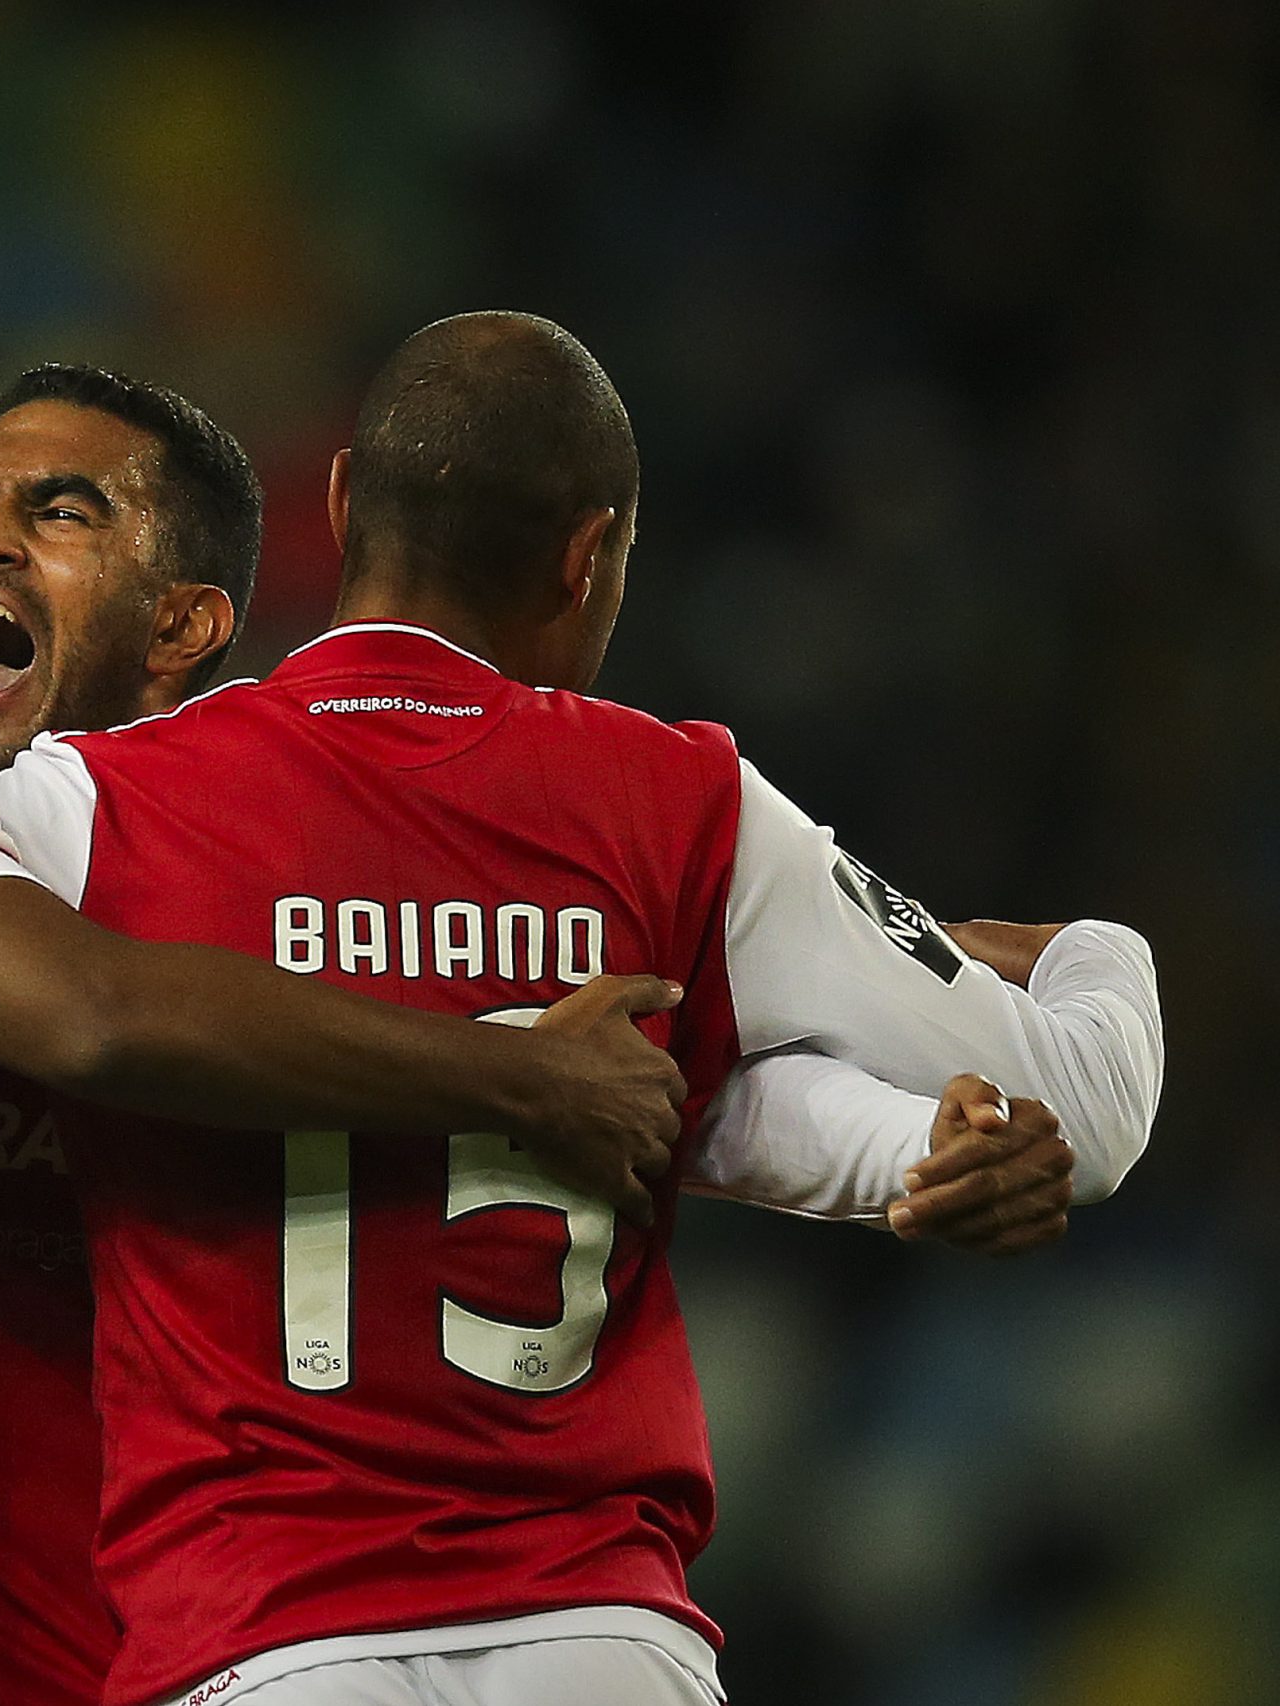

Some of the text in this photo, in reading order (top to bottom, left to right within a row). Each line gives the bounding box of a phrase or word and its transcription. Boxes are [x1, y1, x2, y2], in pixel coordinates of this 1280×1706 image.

[404, 699, 427, 714] DO
[428, 705, 484, 718] MINHO
[274, 895, 604, 986] BAIANO
[305, 1340, 330, 1349] LIGA
[522, 1342, 543, 1351] LIGA
